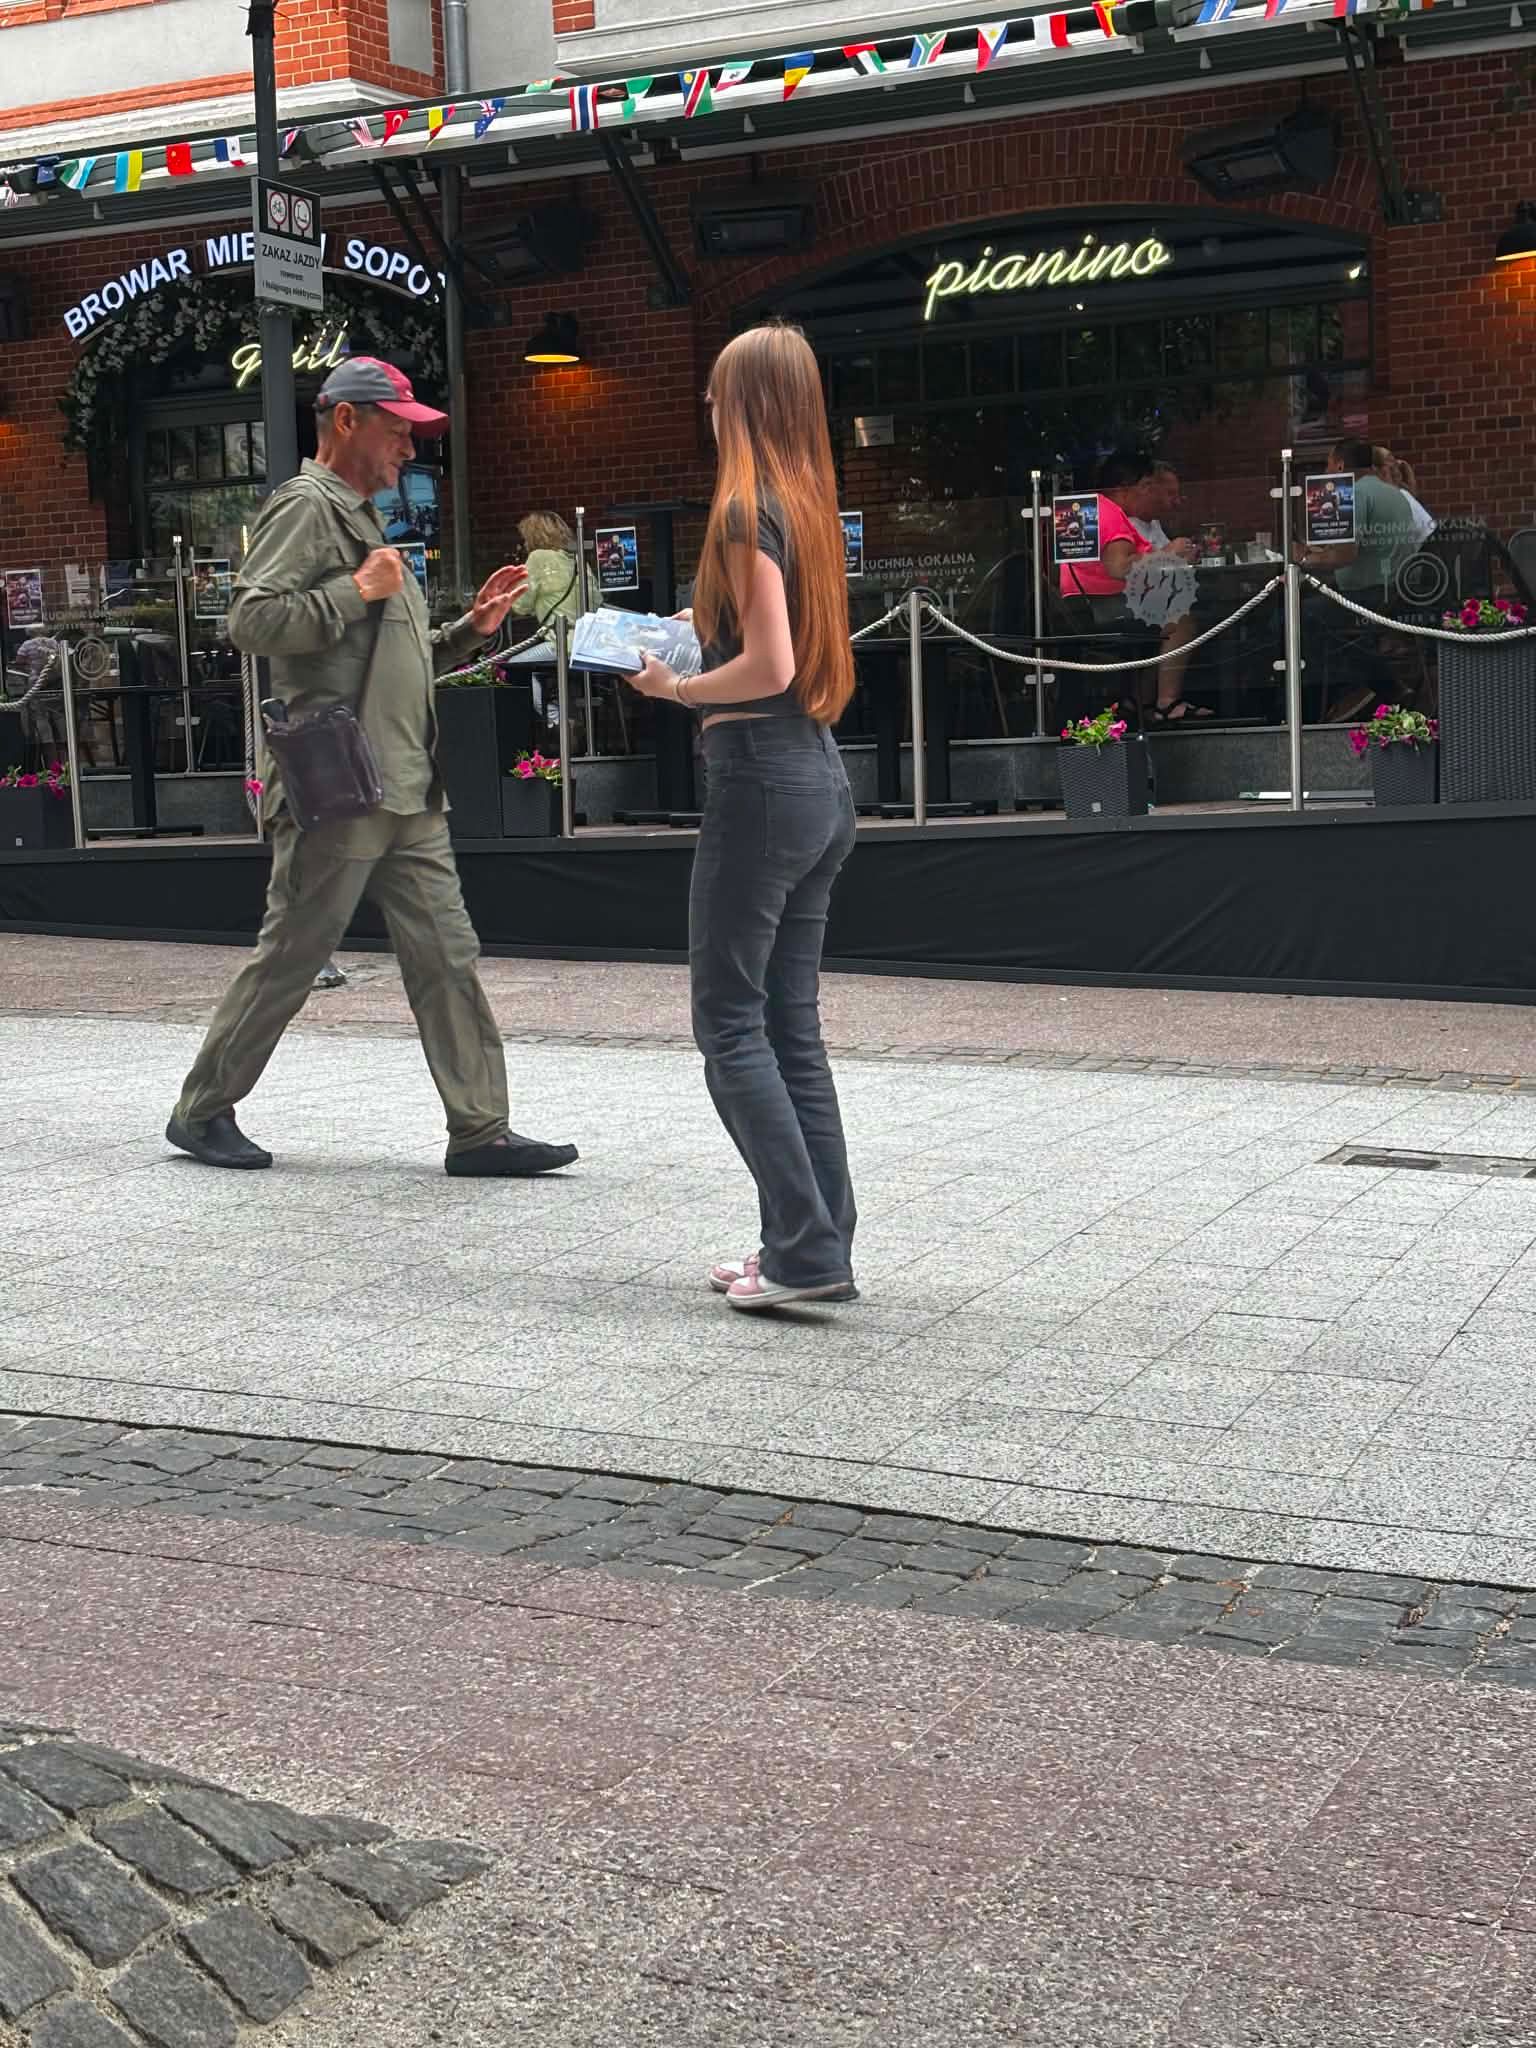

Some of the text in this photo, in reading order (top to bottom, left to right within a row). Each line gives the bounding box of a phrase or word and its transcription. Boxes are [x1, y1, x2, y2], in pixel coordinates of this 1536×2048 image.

[63, 248, 192, 338] BROWAR
[344, 239, 446, 303] SOPO
[261, 243, 320, 270] ZAKAZ JAZDY
[924, 234, 1170, 320] pianino
[231, 320, 348, 388] gill
[863, 556, 914, 571] KUCHNIA
[918, 552, 976, 568] LOKALNA
